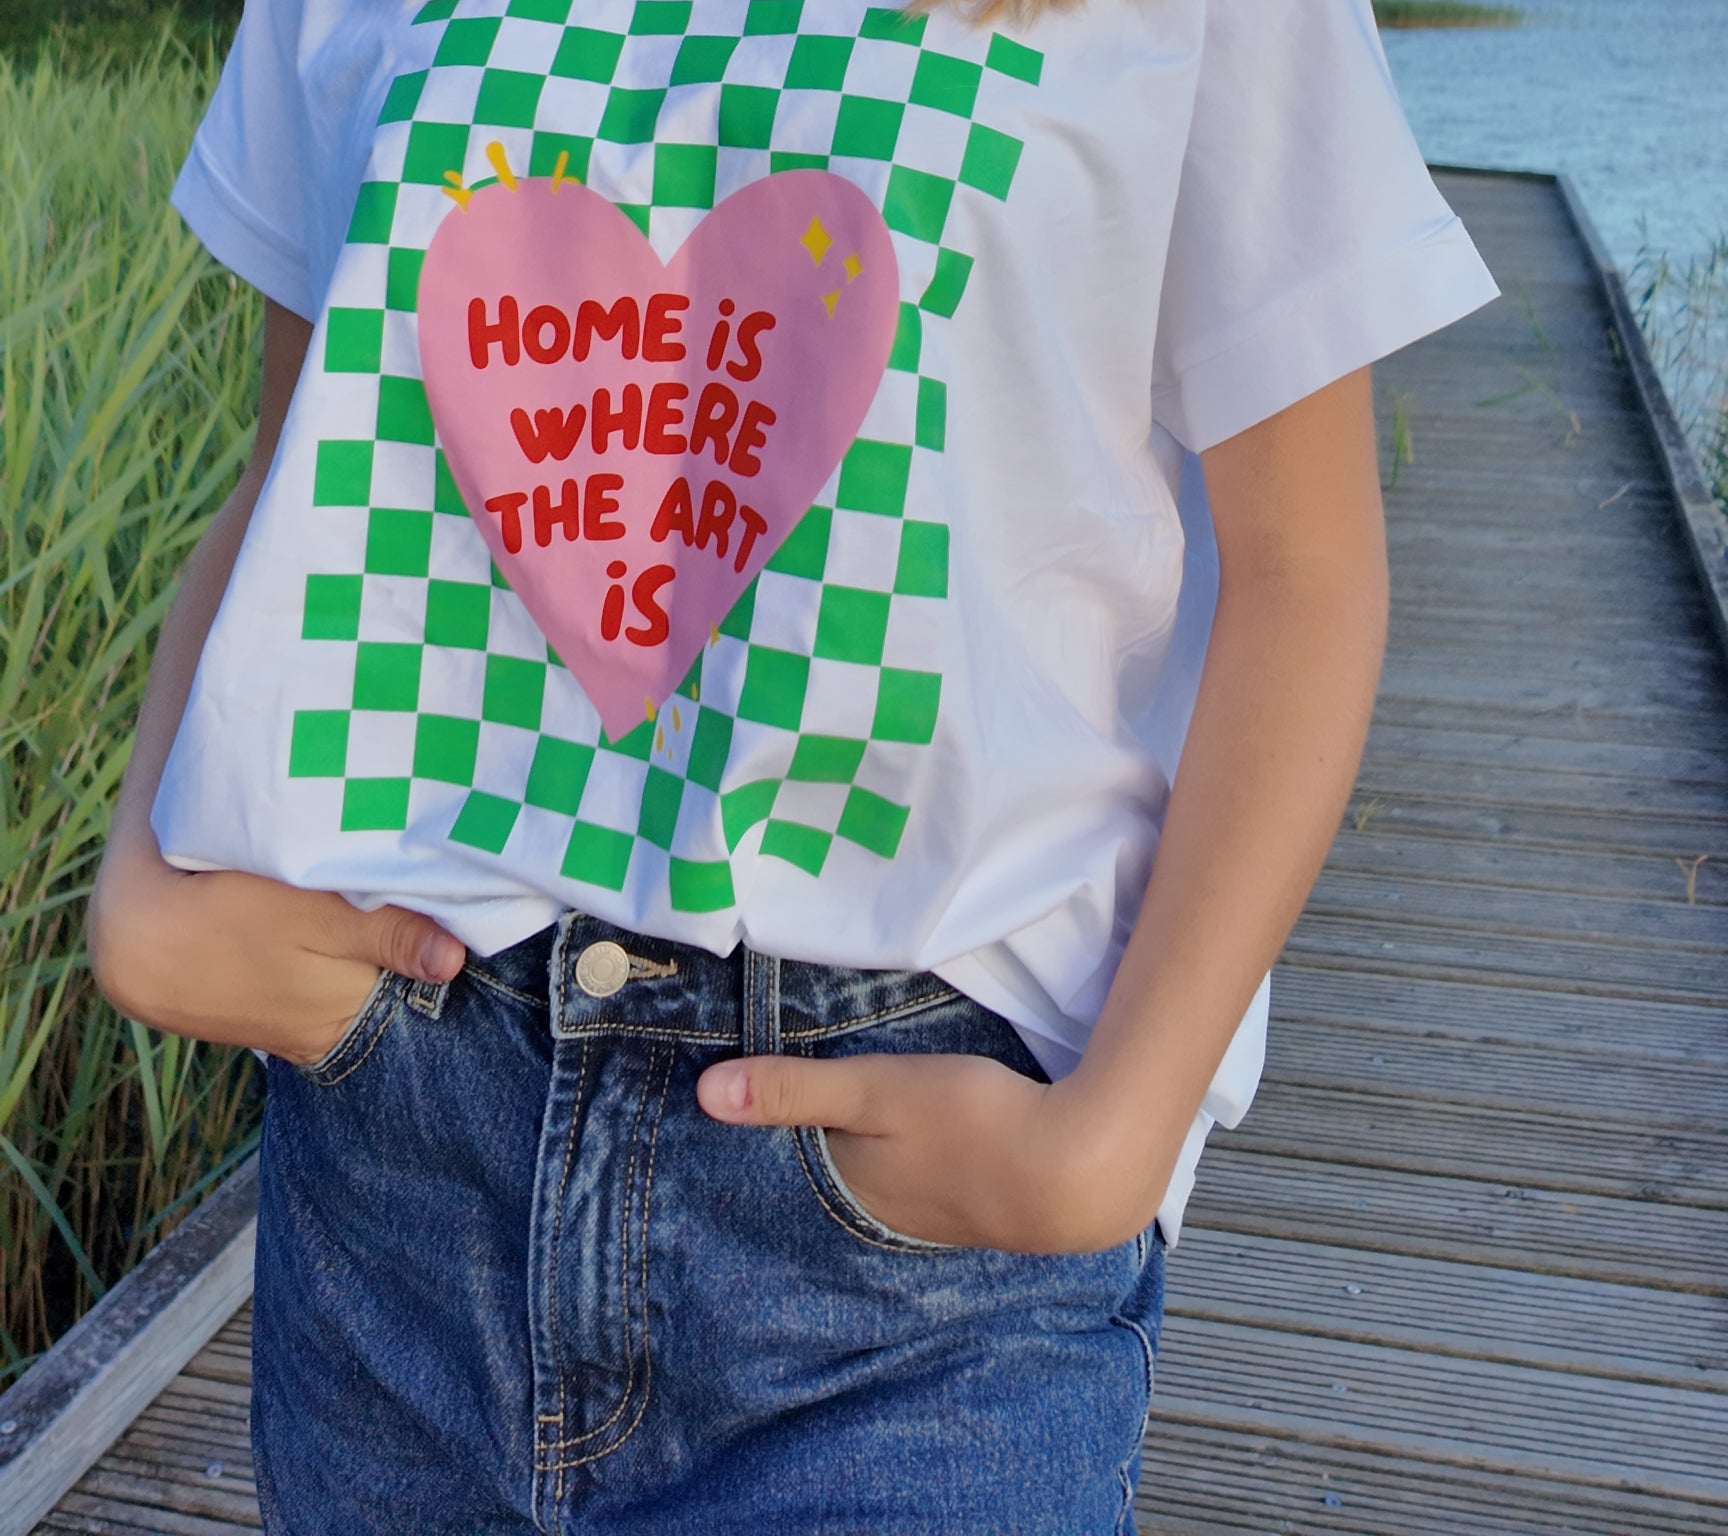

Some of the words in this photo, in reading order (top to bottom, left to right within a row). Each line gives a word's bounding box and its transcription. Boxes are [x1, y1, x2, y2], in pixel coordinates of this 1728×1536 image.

[467, 293, 690, 370] HOME
[510, 382, 777, 478] WHERE
[485, 473, 626, 554] THE
[650, 476, 768, 574] ART
